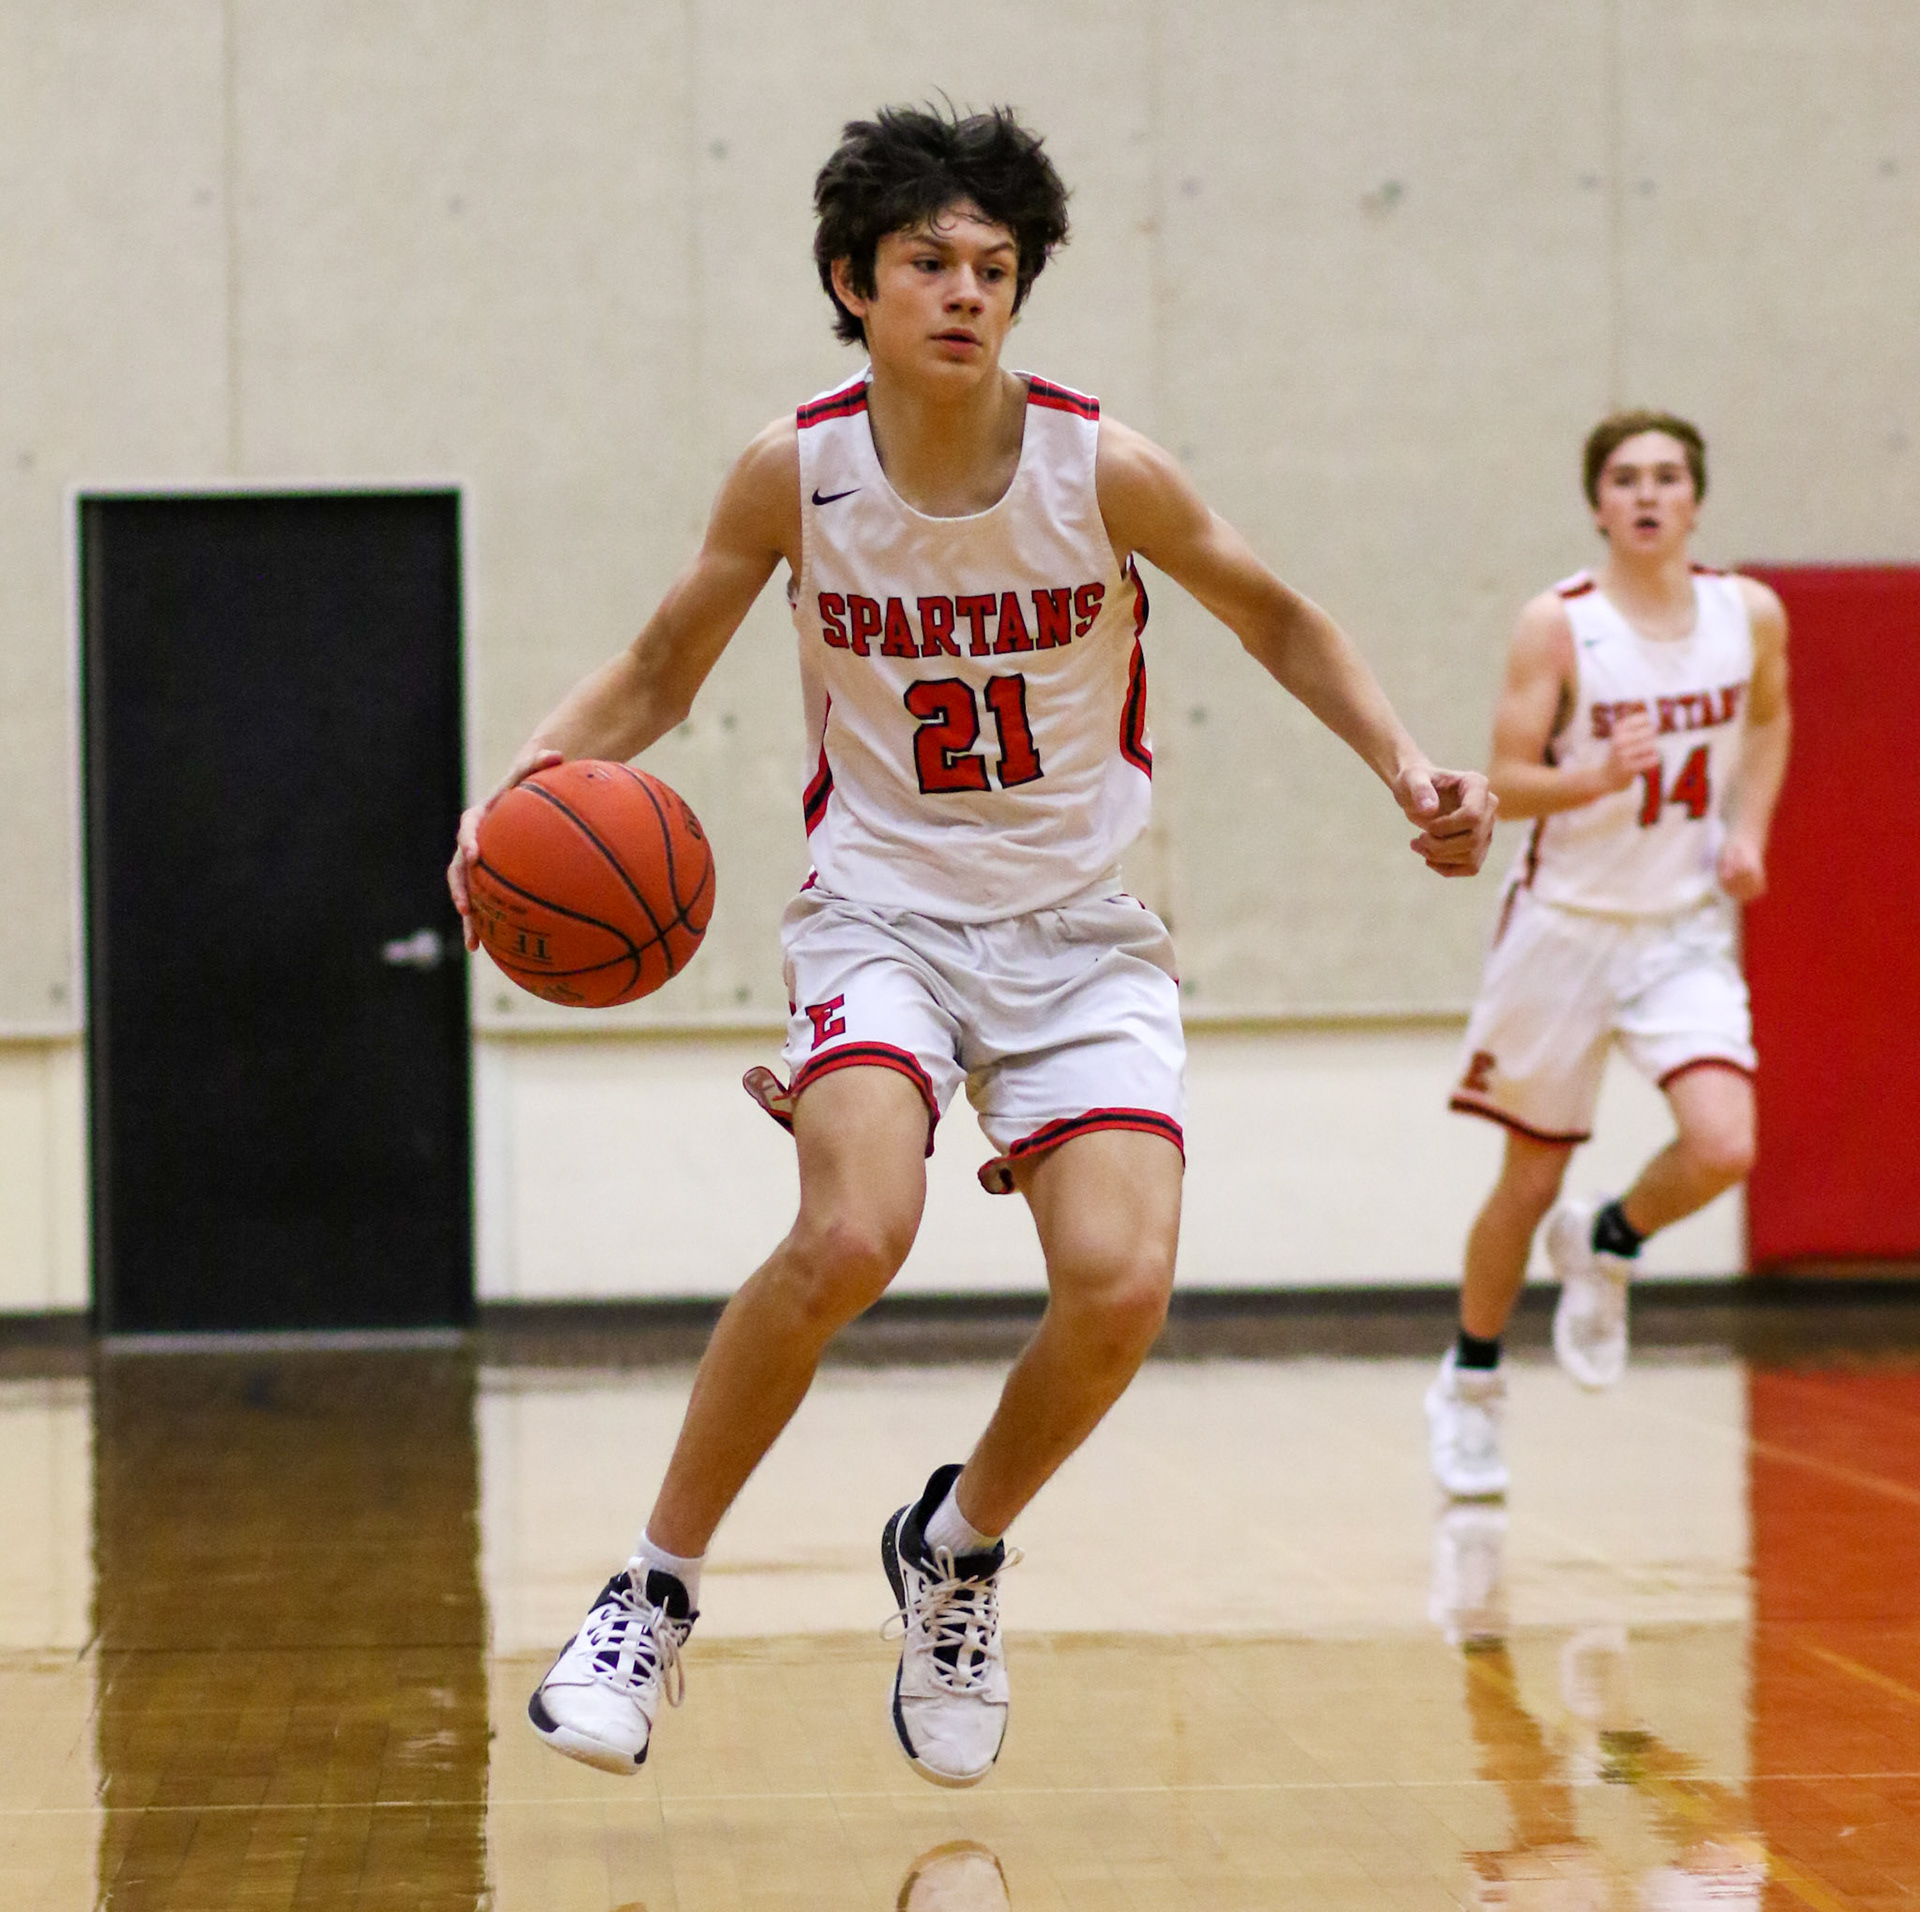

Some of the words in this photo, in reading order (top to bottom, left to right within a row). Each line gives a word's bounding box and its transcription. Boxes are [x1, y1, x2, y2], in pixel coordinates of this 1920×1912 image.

[818, 581, 1106, 659] SPARTANS
[903, 672, 1045, 795] 21
[1638, 744, 1709, 829] 14
[804, 993, 846, 1051] E
